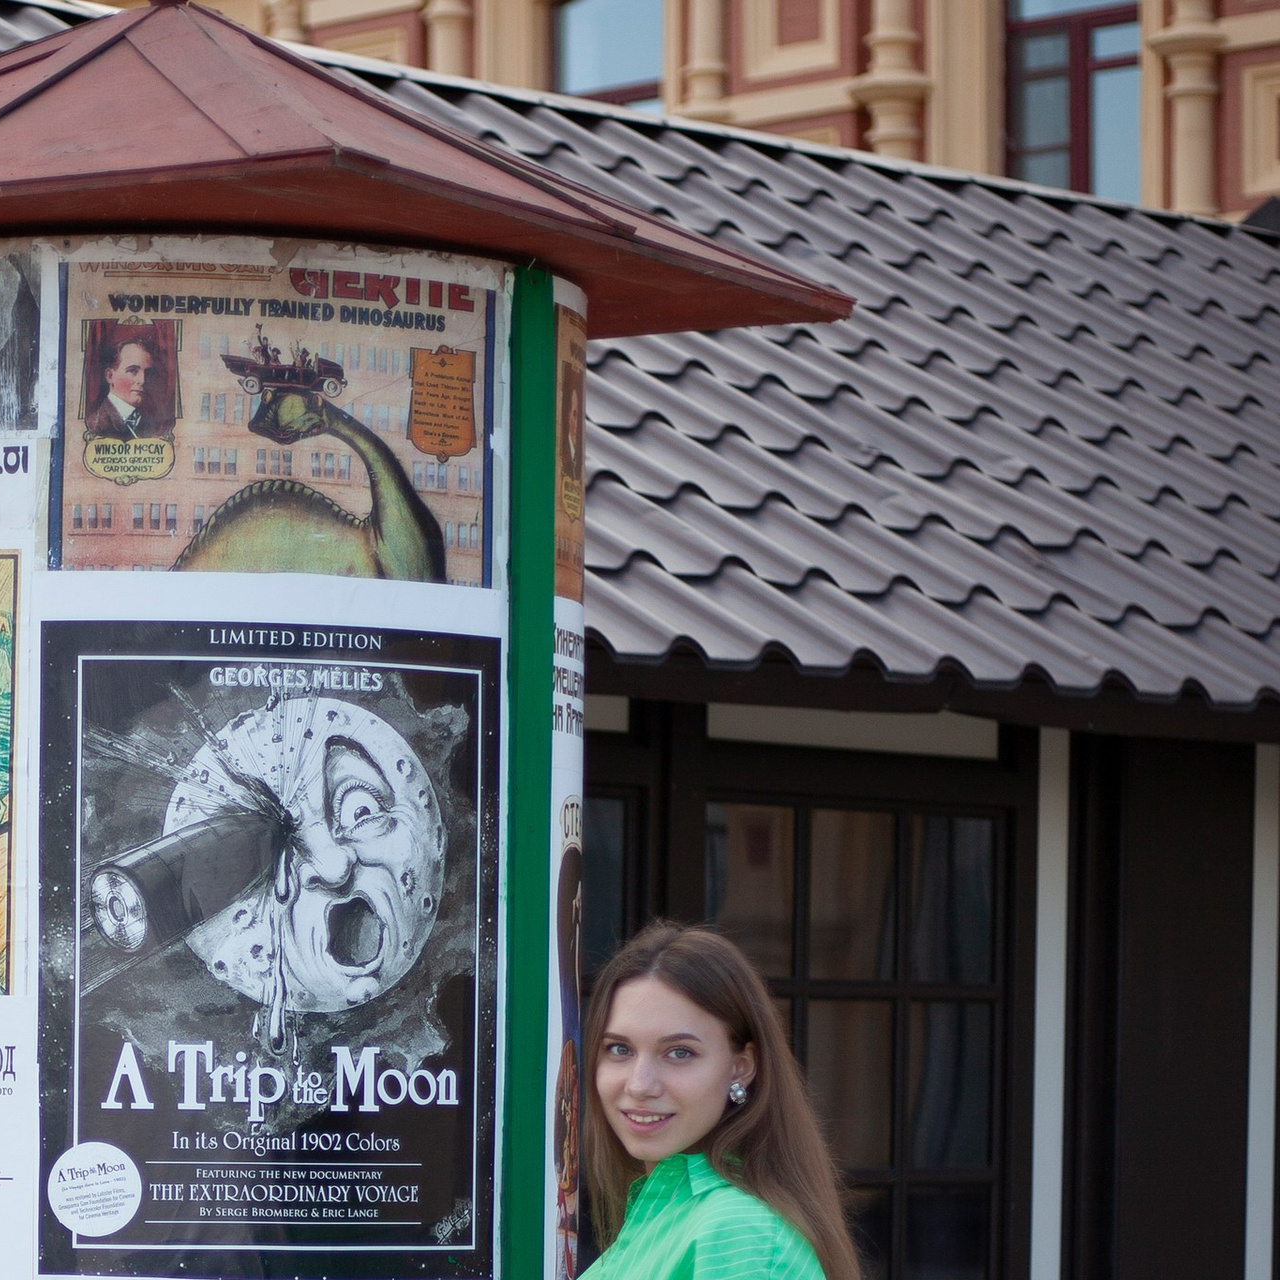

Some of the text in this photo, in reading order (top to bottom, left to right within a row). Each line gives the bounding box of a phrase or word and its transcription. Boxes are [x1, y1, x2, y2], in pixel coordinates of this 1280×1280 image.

[109, 294, 445, 332] WONDERFULLY TRAINED DINOSAURUS
[95, 444, 131, 455] WINSOR
[209, 629, 382, 650] LIMITED EDITION
[209, 666, 383, 691] GEORGES MÉLIÈS
[101, 1040, 459, 1122] A Trip to the Moon
[172, 1131, 400, 1157] In its Original 1902 Colors
[57, 1169, 66, 1183] A
[67, 1168, 89, 1180] Trip
[97, 1163, 125, 1176] Moon
[196, 1168, 383, 1180] FEATURING THE NEW DOCUMENTARY
[150, 1184, 419, 1203] THE EXTRAORDINARY VOYAGE
[199, 1207, 379, 1218] BY SERGE BROMBERG & ERIC LANGE
